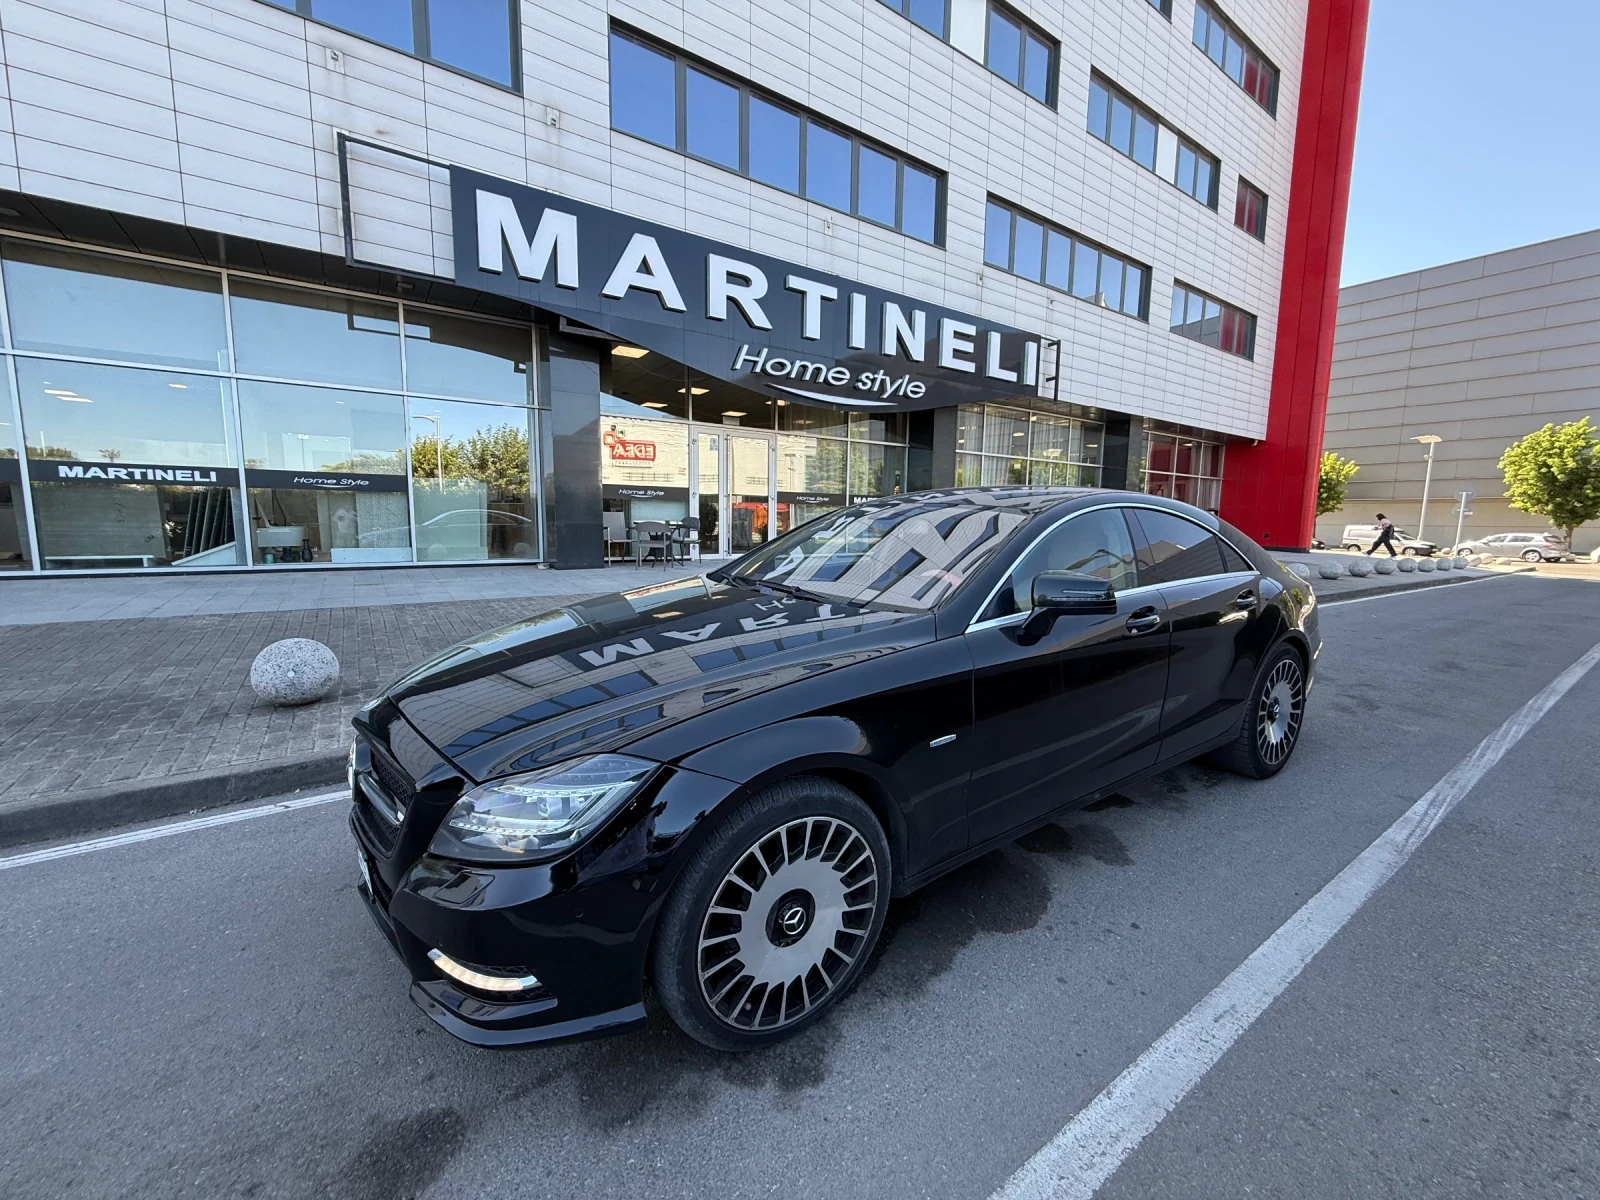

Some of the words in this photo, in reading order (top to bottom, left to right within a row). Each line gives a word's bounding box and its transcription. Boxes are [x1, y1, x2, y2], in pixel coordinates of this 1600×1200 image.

[475, 188, 1038, 387] MARTINELI
[731, 343, 850, 386] Home
[855, 369, 926, 399] style
[57, 465, 217, 482] MARTINELI
[293, 476, 337, 485] Home
[339, 478, 370, 487] Style
